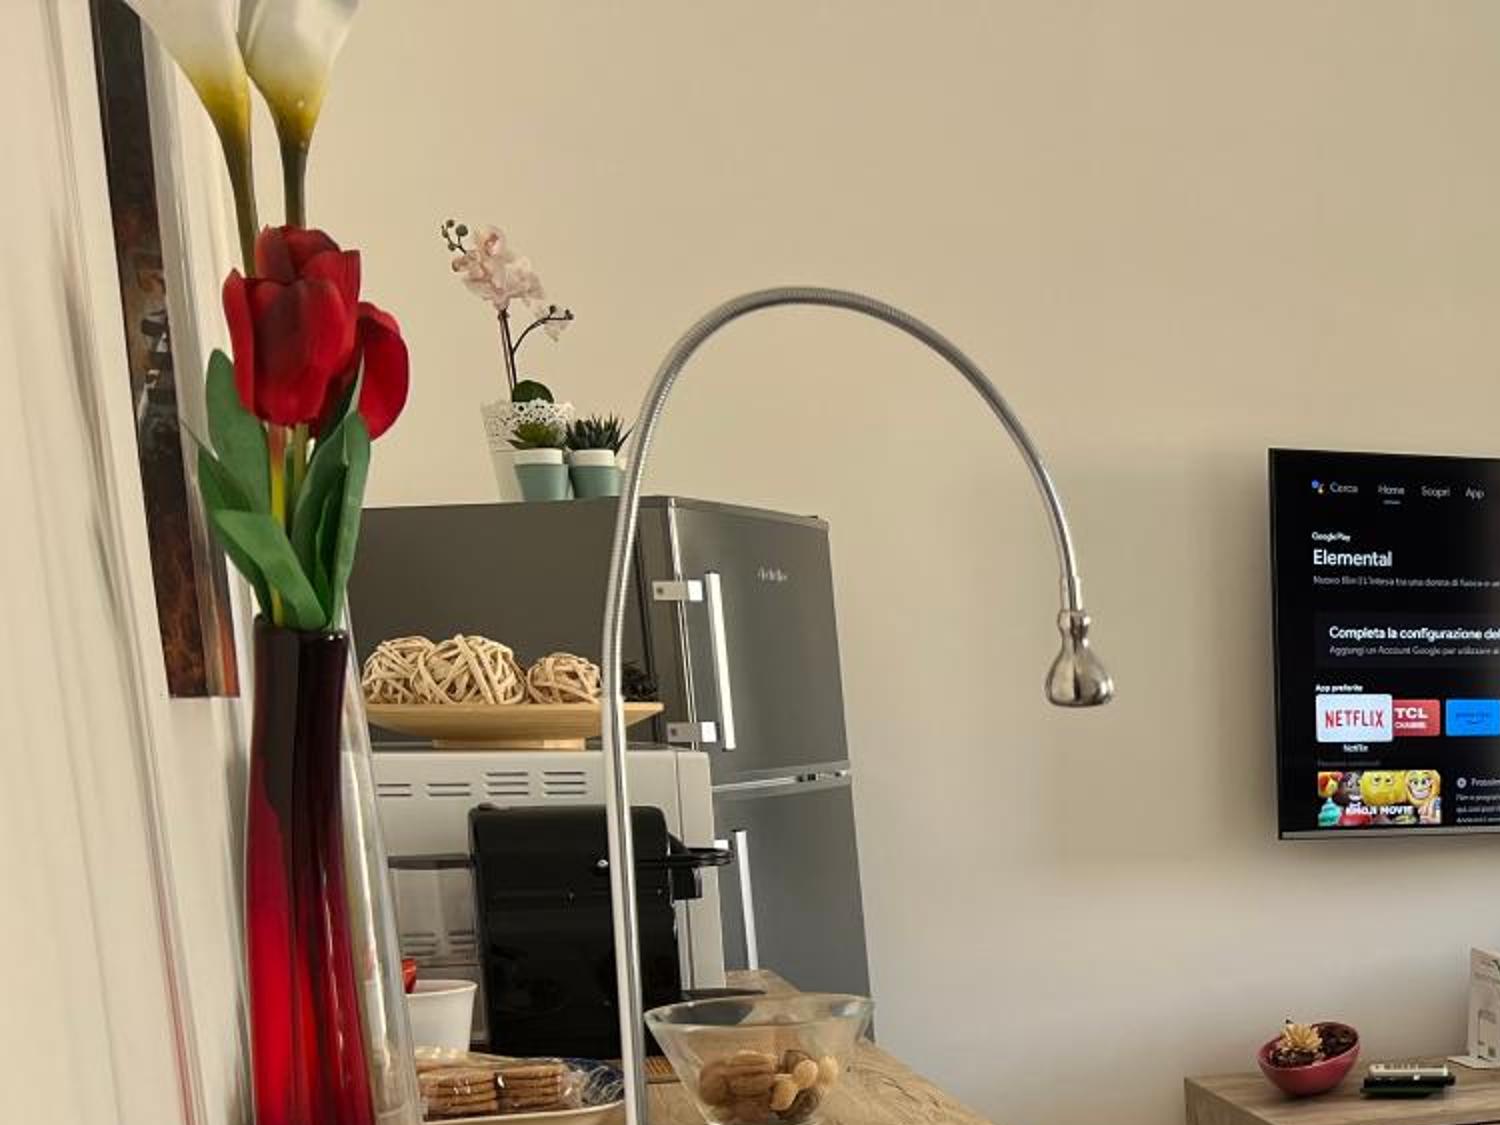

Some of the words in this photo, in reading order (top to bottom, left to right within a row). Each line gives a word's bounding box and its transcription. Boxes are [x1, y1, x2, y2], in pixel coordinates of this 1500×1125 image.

[1329, 482, 1358, 494] Cerca
[1378, 484, 1405, 496] Home
[1421, 485, 1450, 498] Scopri
[1465, 488, 1485, 500] App
[1311, 531, 1336, 543] Google
[1313, 549, 1393, 567] Elemental
[1329, 626, 1386, 641] Completa
[1387, 626, 1398, 639] la
[1400, 626, 1482, 642] configurazione
[1315, 684, 1333, 694] App
[1325, 709, 1385, 729] NETFLIX
[1395, 707, 1428, 720] TCL
[1343, 743, 1369, 753] Netflix
[1379, 805, 1414, 816] MOVIE
